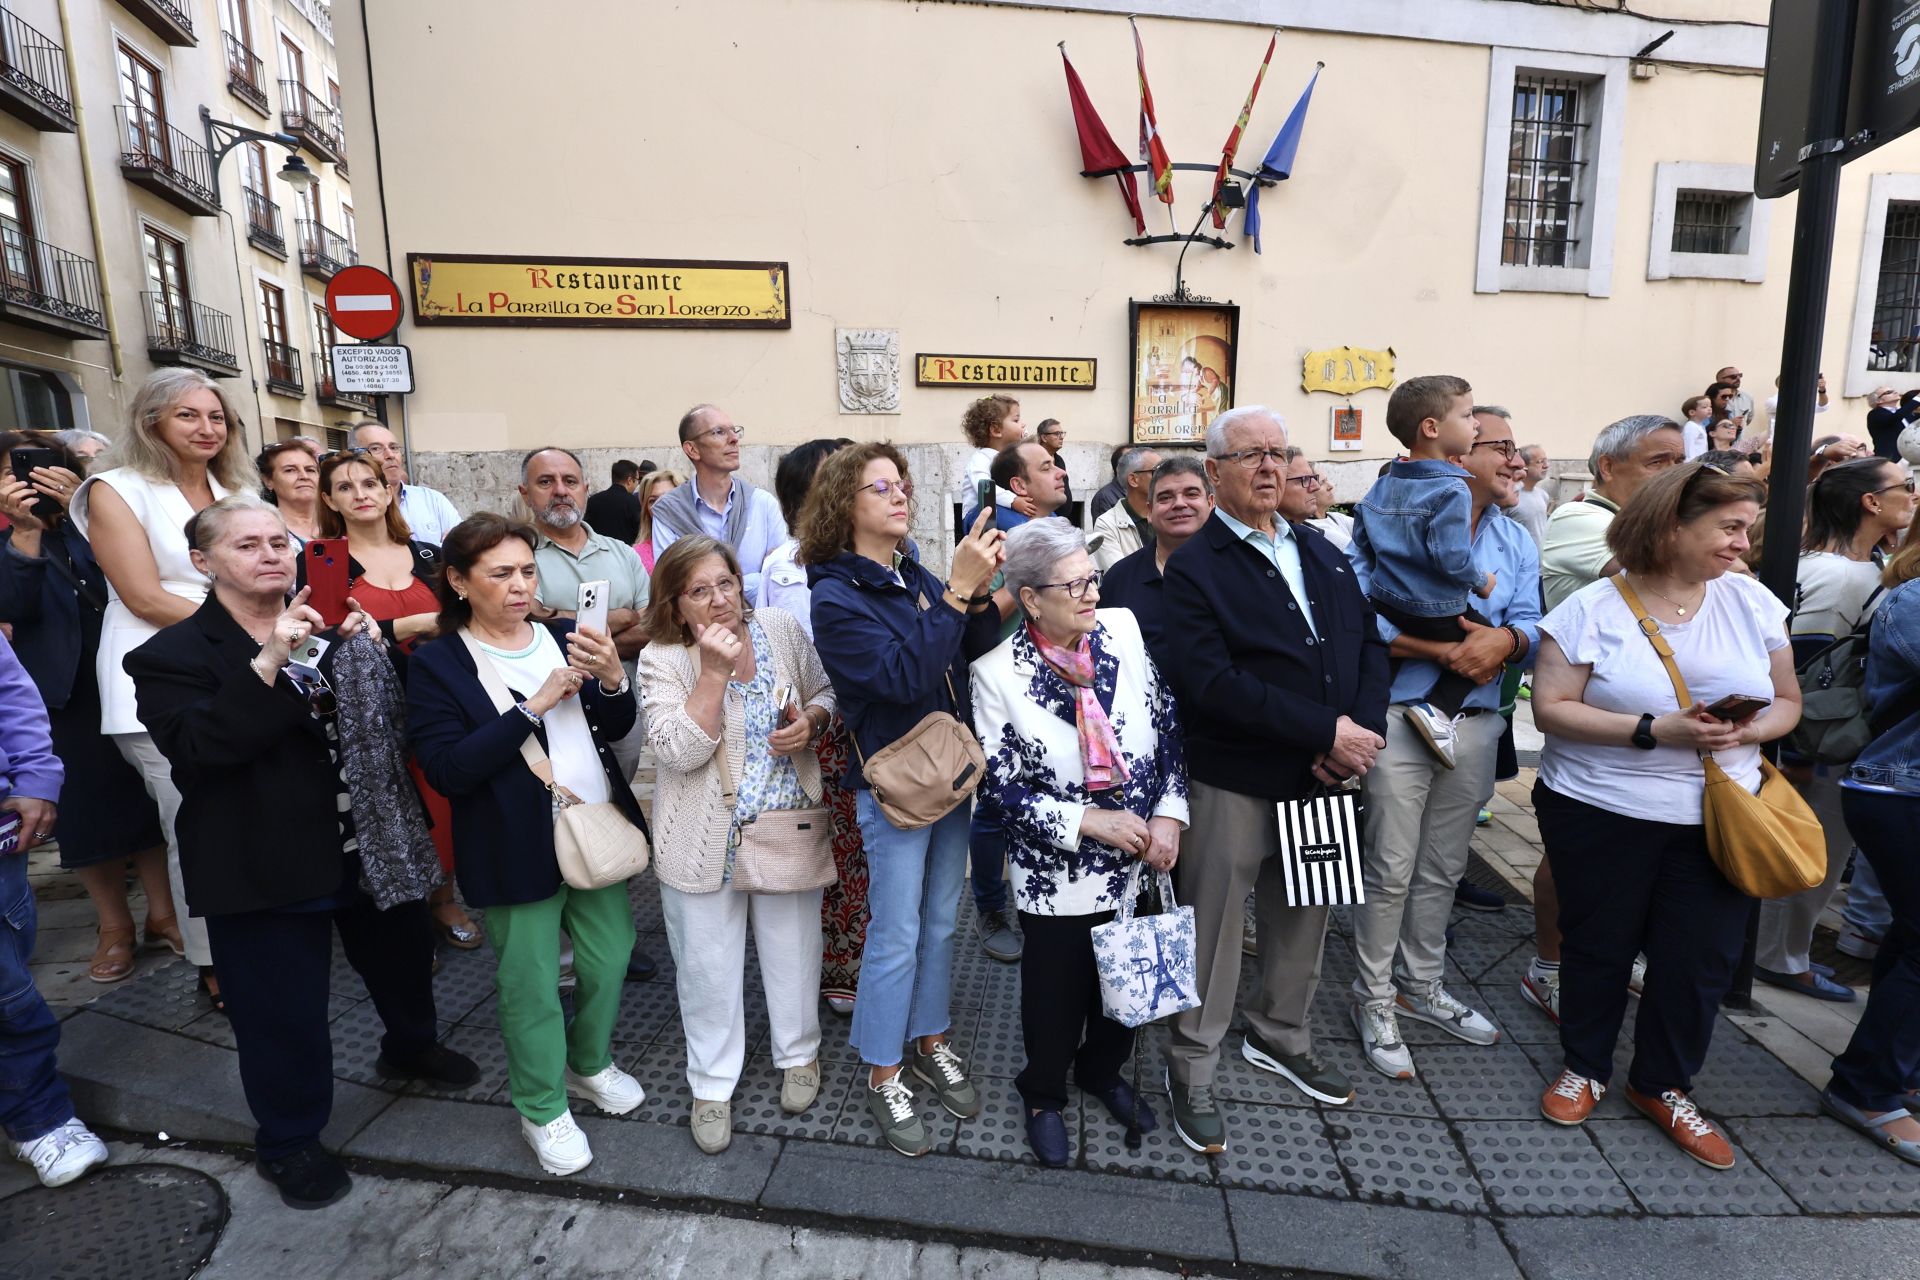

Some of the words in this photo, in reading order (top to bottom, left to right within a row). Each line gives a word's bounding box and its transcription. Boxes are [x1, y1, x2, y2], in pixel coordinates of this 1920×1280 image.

[525, 267, 683, 292] Restaurante
[456, 291, 483, 313] La
[488, 291, 580, 314] Parrilla
[584, 301, 612, 315] de
[616, 294, 665, 316] San
[668, 295, 751, 318] Lorenzo
[336, 348, 374, 356] EXCEPTO
[374, 348, 402, 356] VADOS
[341, 355, 399, 363] AUTORIZADOS
[933, 358, 1080, 383] Restaurante
[1321, 355, 1377, 383] BAR
[1138, 421, 1165, 437] San
[1167, 419, 1207, 435] Loren
